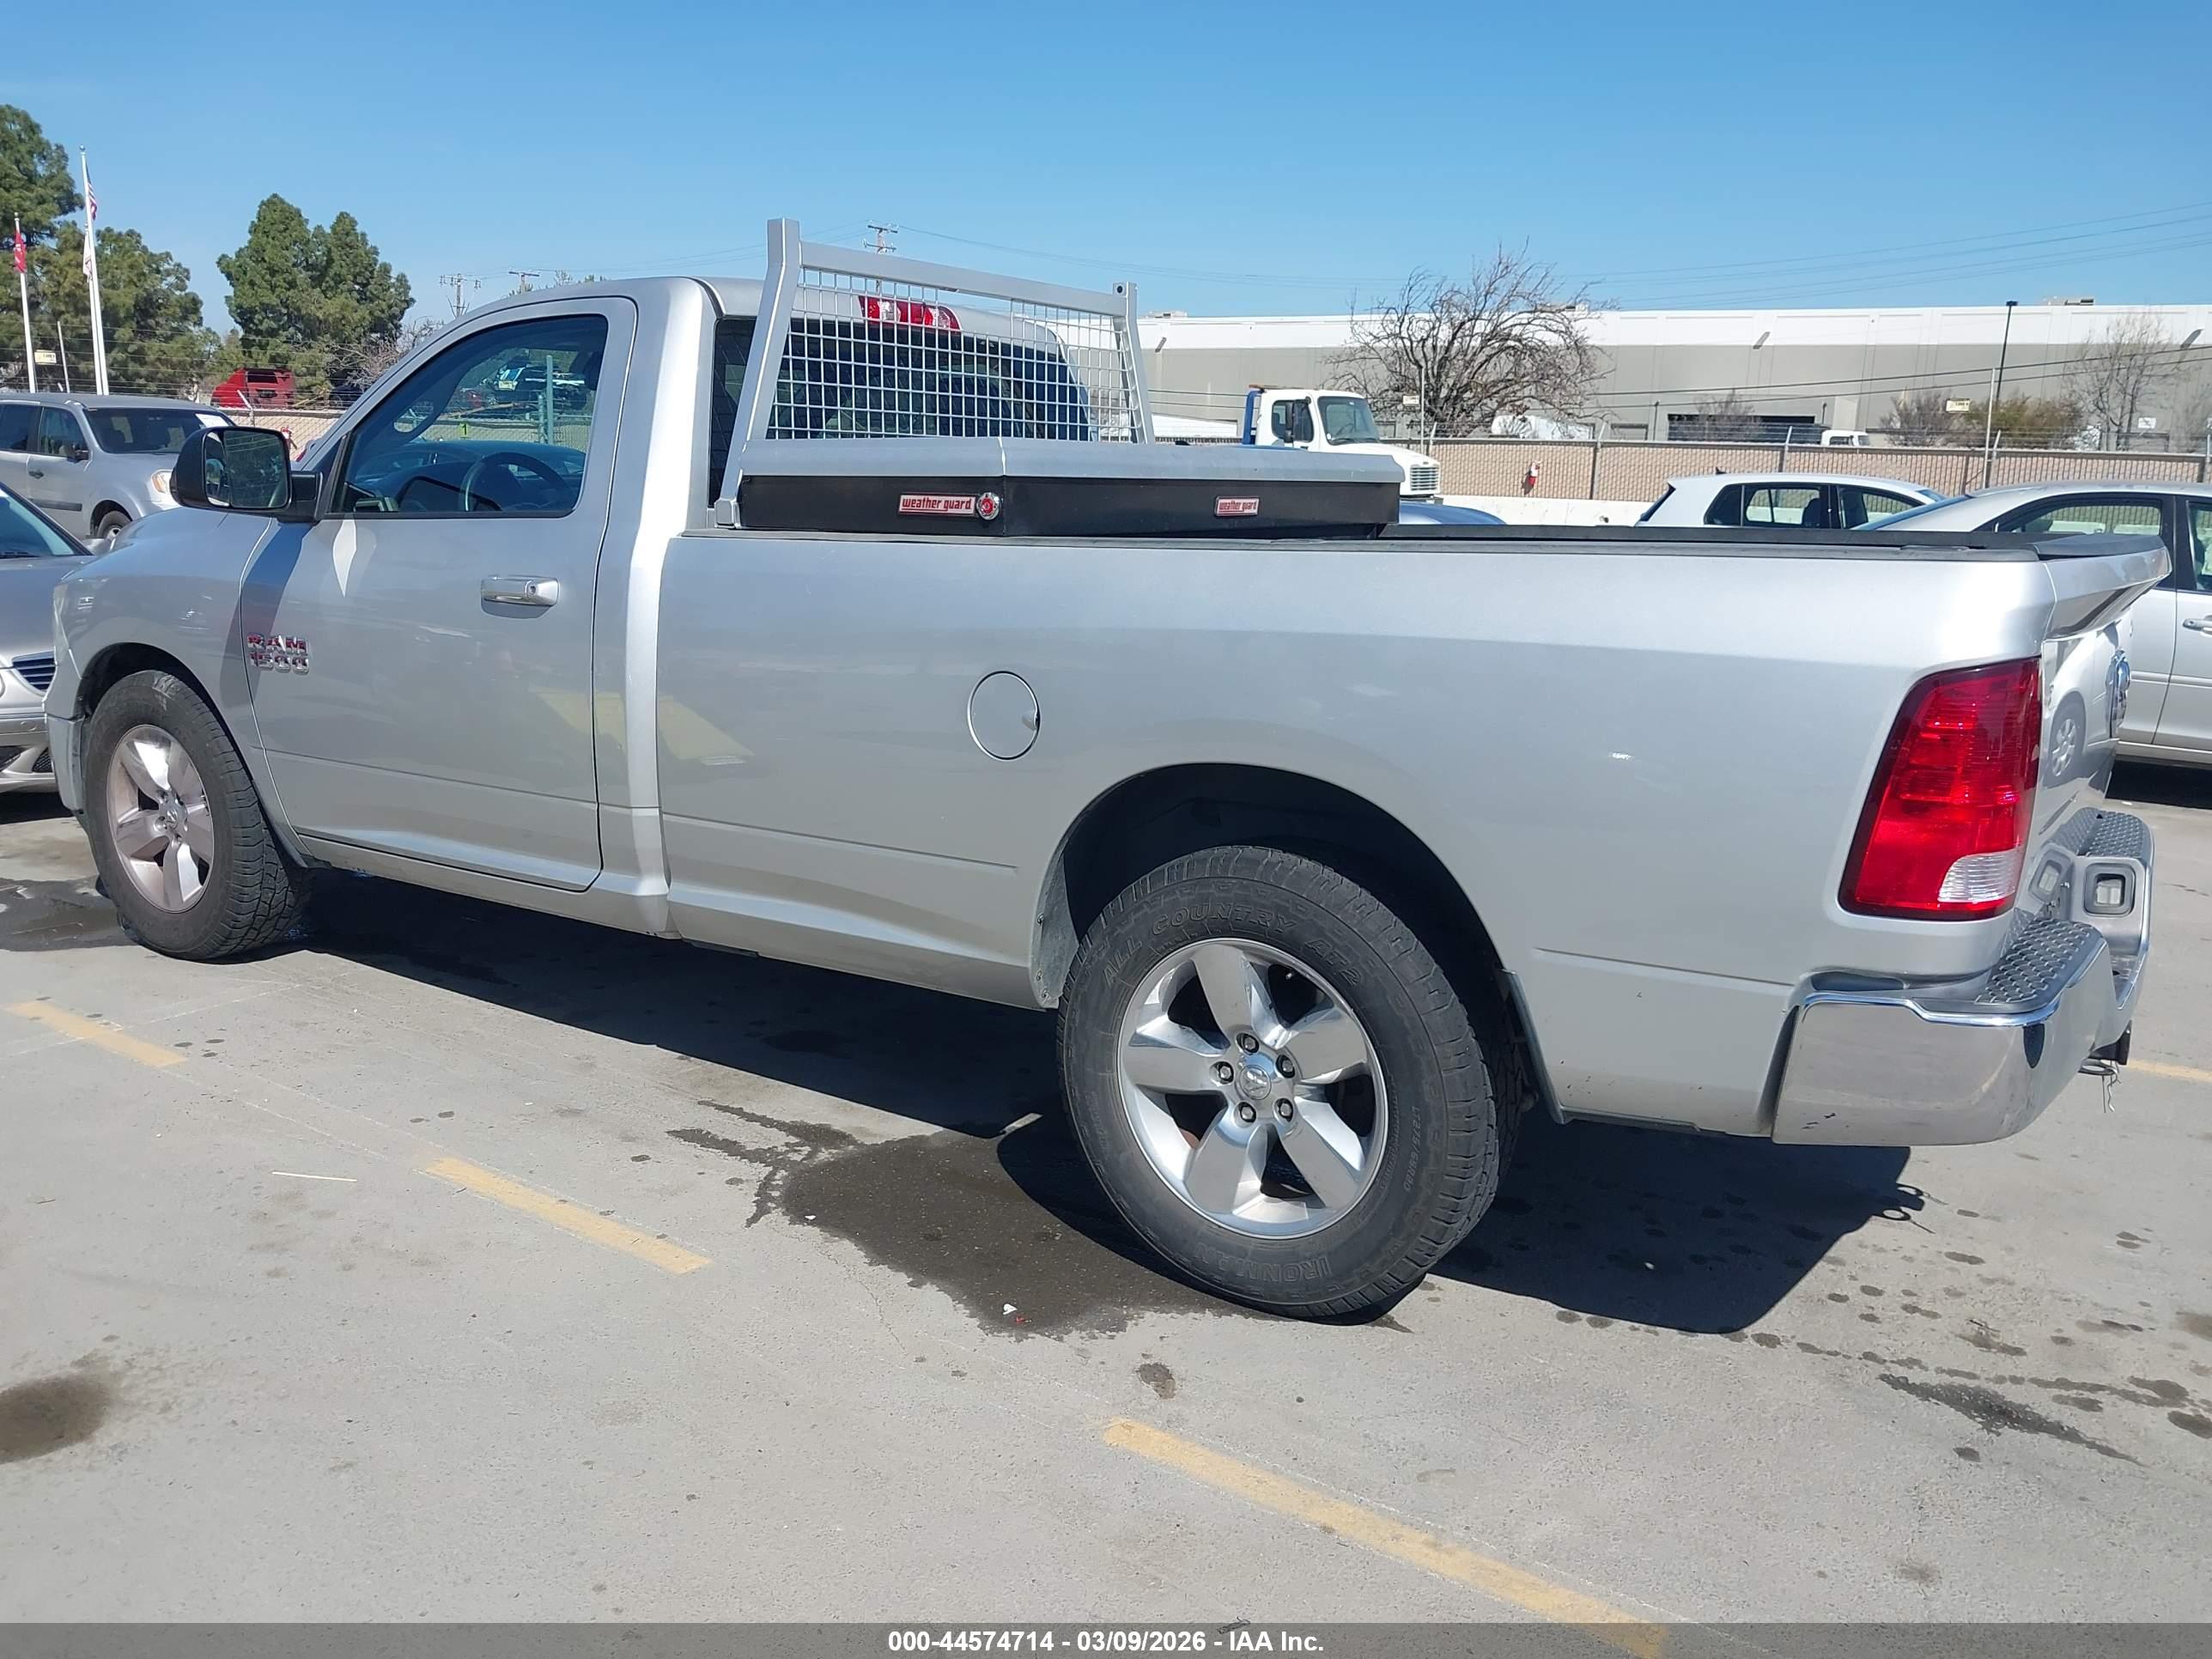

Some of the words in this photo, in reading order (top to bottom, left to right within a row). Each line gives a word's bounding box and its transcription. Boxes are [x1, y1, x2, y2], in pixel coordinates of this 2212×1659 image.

[902, 497, 942, 509] weather
[944, 498, 972, 511] guard
[247, 634, 307, 653] RAM
[1103, 938, 1143, 987] ALL
[1152, 902, 1297, 936] COUNTRY
[1304, 939, 1364, 988] AT2
[1193, 1242, 1333, 1283] IRONMAN
